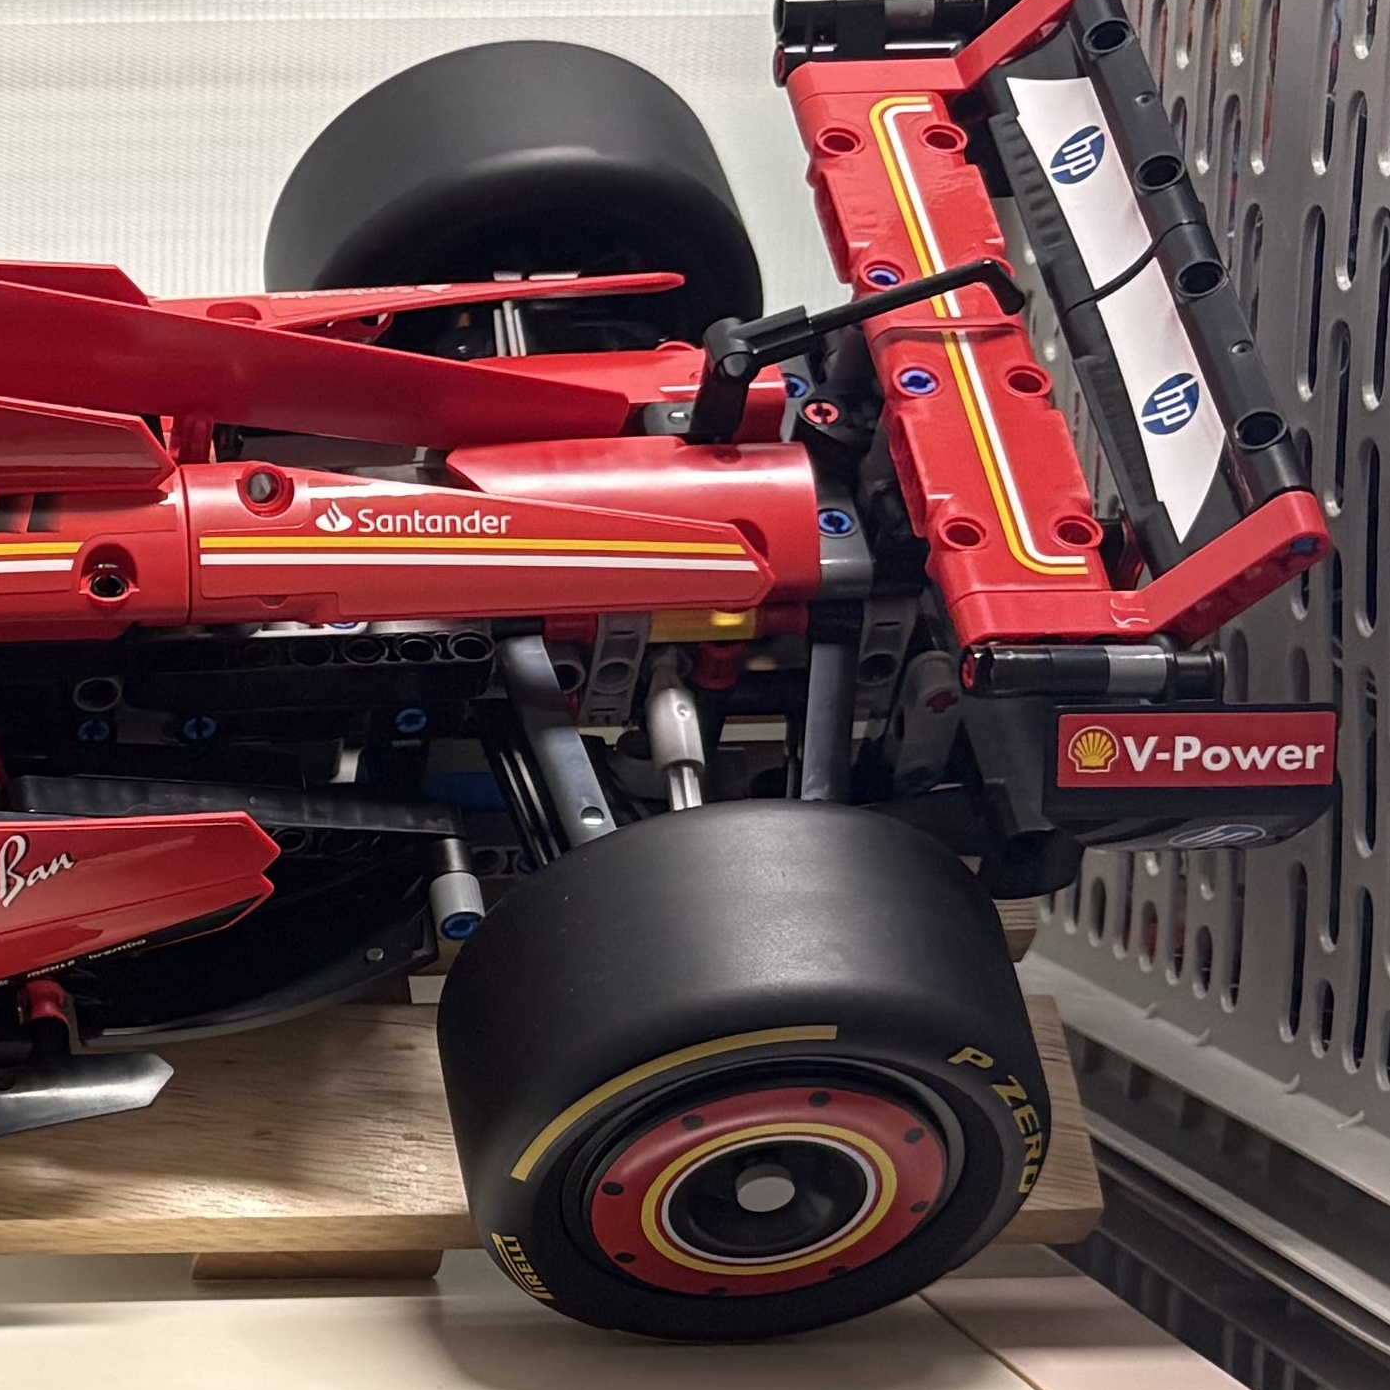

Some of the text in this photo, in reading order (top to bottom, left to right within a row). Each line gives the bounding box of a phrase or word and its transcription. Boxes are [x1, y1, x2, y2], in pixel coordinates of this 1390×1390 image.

[1049, 125, 1105, 185] hp
[1141, 372, 1201, 436] hp
[357, 508, 512, 535] Santander
[1123, 734, 1326, 773] V-Power
[947, 1045, 1041, 1194] P ZERO
